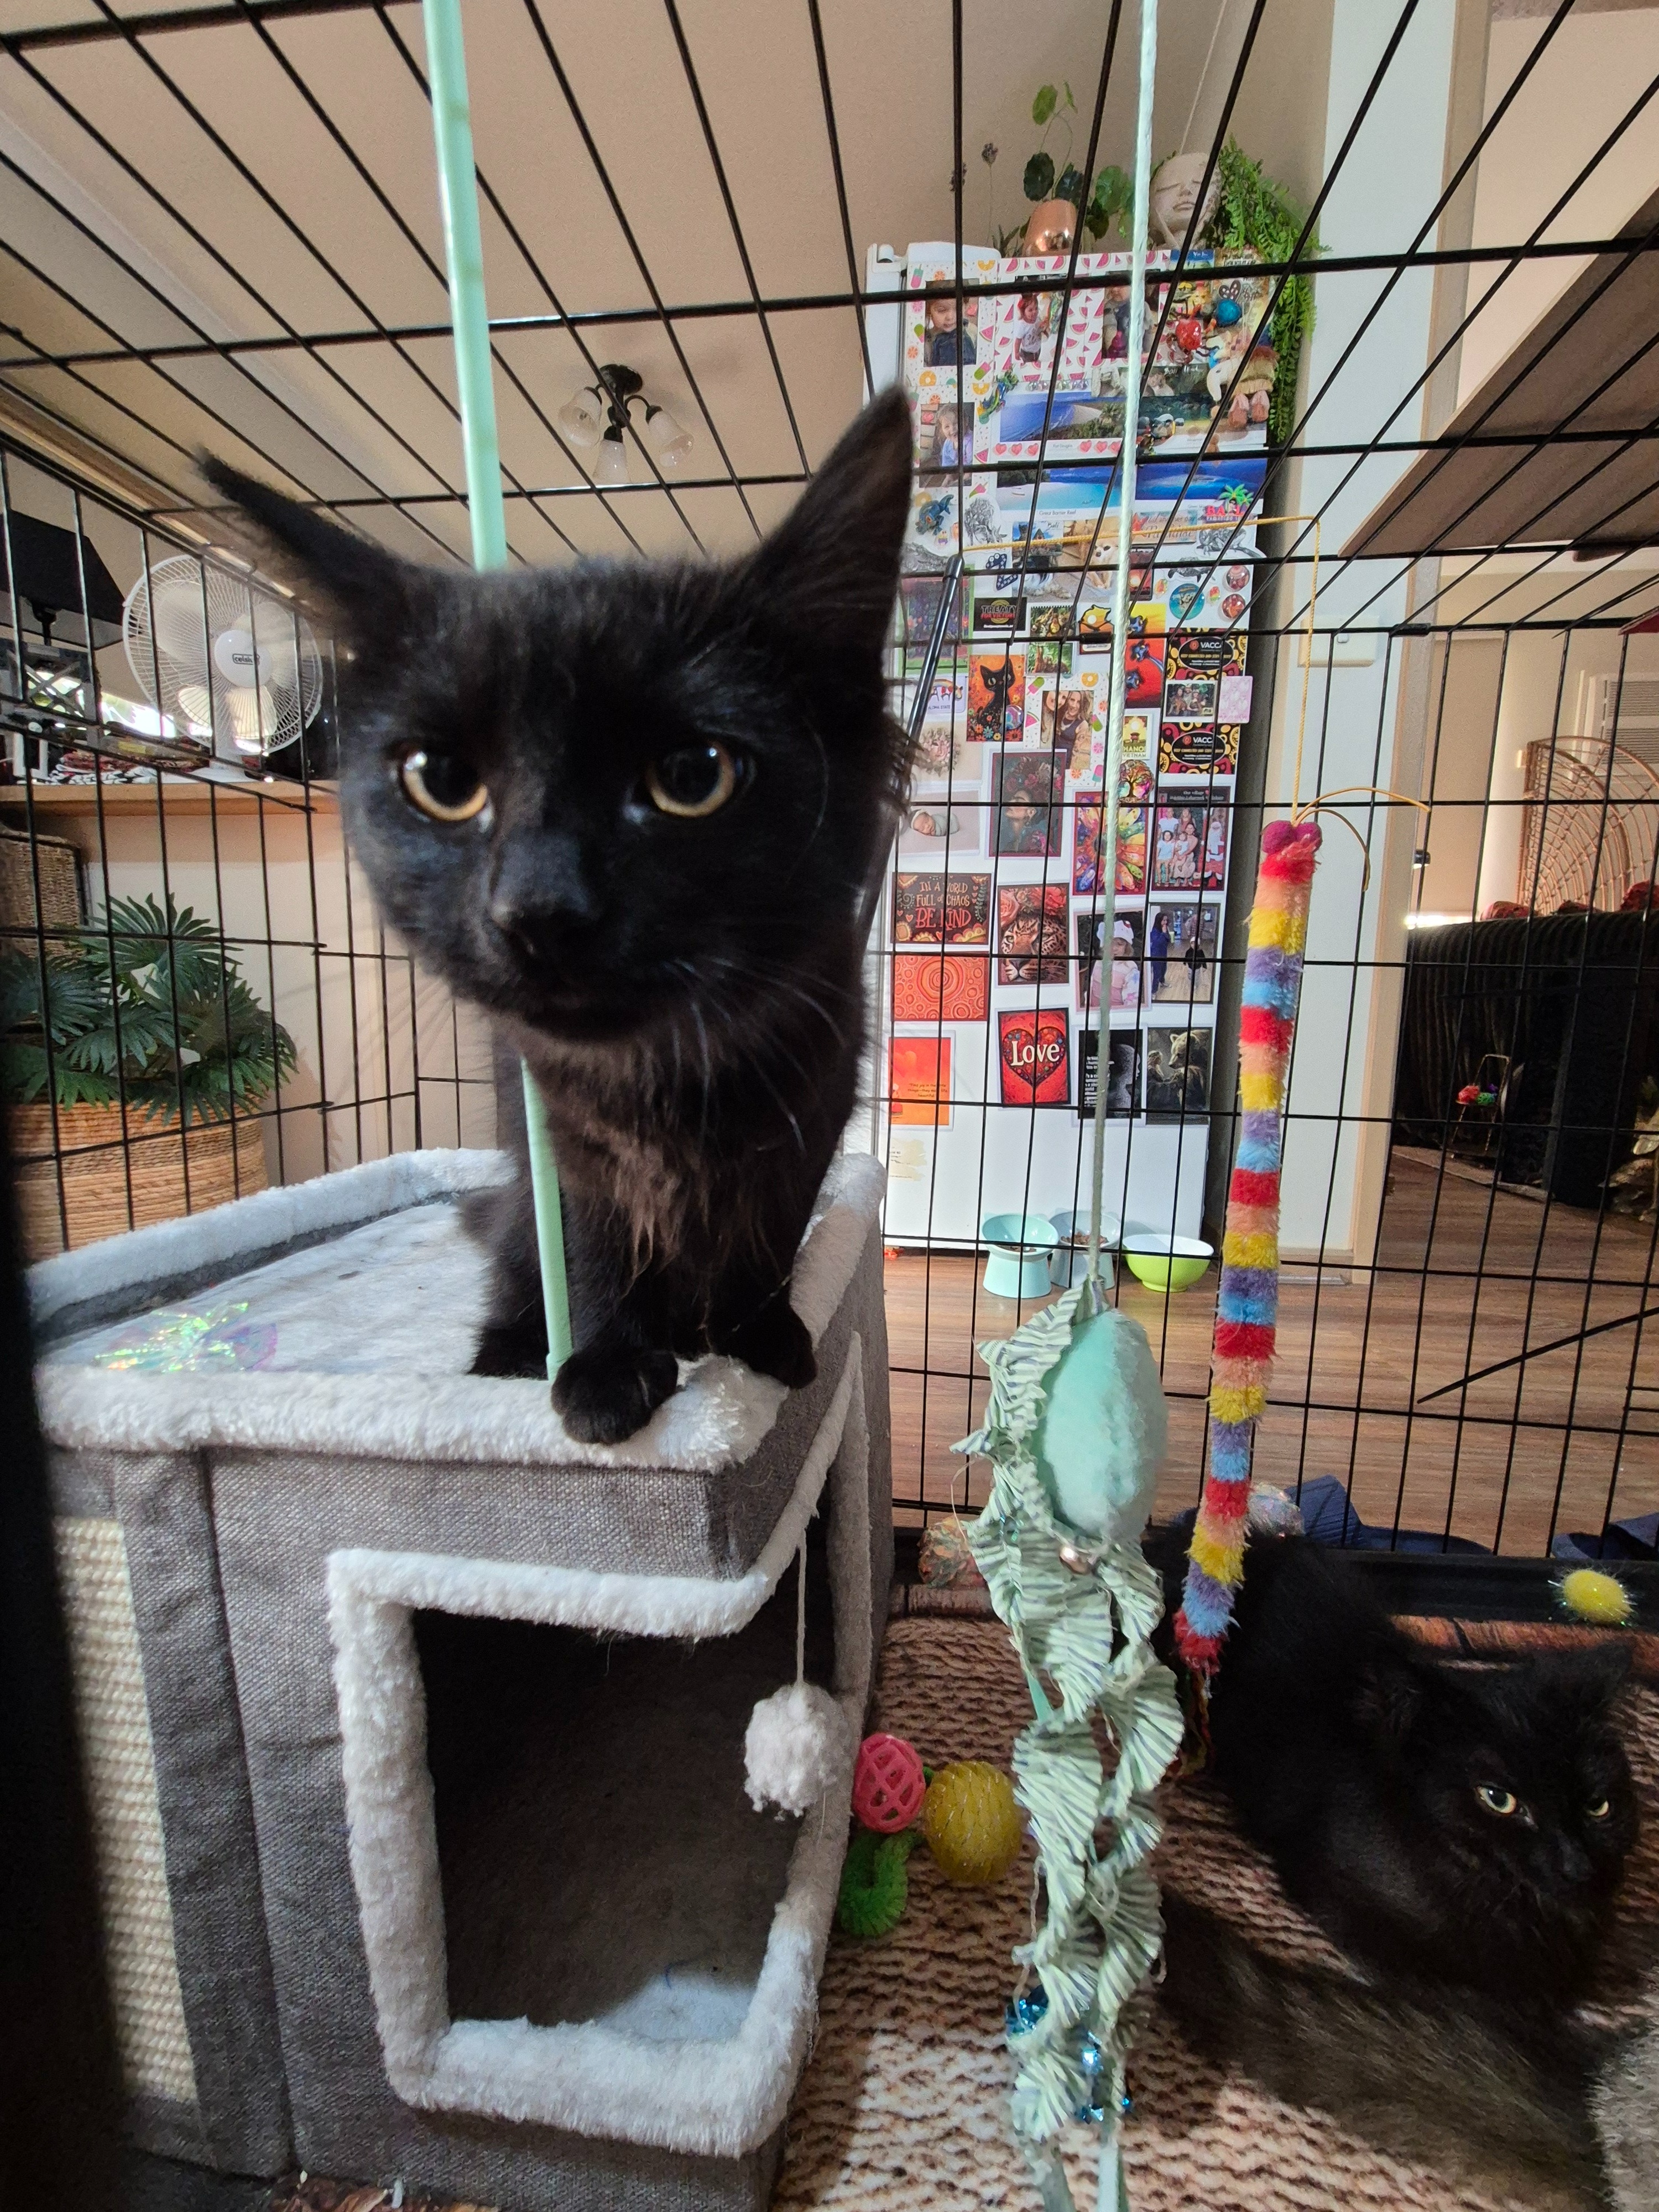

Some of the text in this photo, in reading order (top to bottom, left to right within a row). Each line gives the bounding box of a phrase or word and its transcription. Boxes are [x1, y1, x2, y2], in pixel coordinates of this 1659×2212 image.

[980, 604, 1018, 613] TREATY
[920, 881, 931, 892] IN
[934, 882, 941, 891] A
[946, 895, 970, 907] CHAOS
[915, 907, 936, 928] BE
[1010, 1040, 1060, 1066] Love
